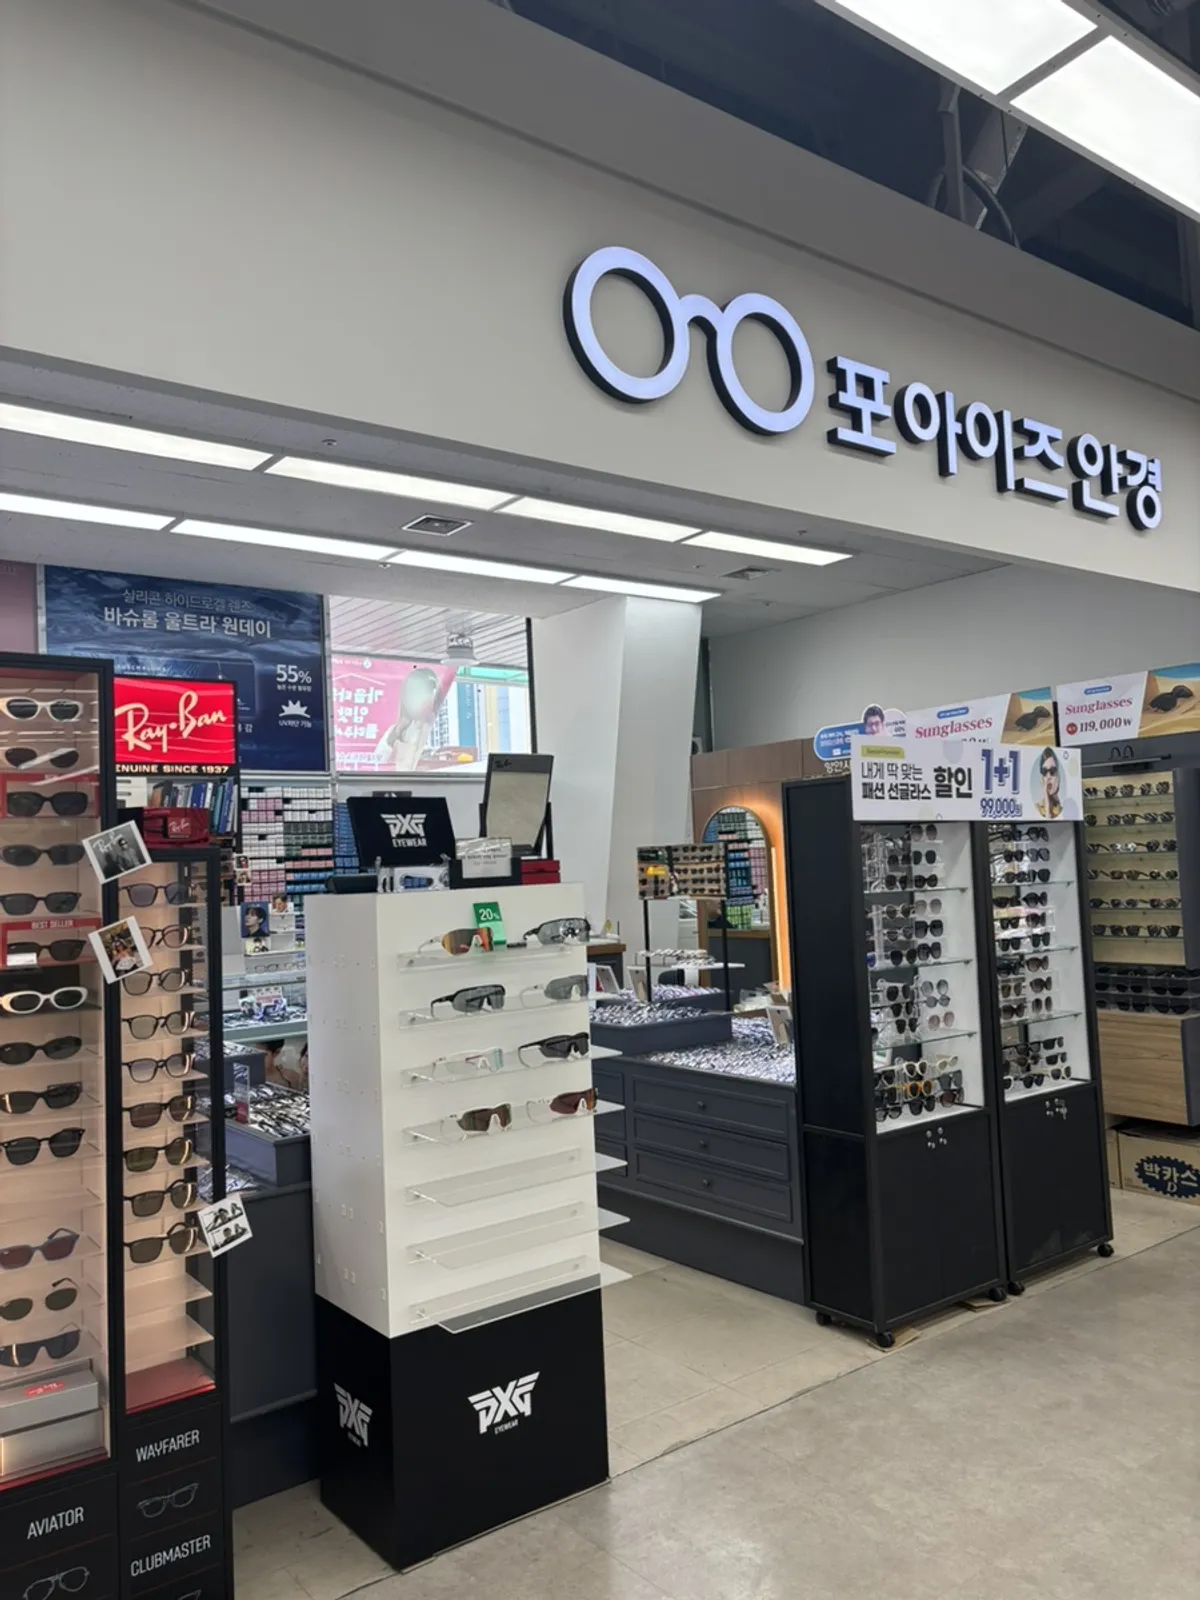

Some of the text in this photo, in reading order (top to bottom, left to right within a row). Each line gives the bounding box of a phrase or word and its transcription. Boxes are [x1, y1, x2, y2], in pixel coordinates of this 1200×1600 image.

[122, 588, 161, 606] 실리콘
[104, 607, 271, 638] 바슈롬 울트라 원데이
[276, 664, 312, 683] 55%
[1065, 697, 1133, 716] Sunglasses
[915, 717, 992, 739] Sunglasses
[163, 765, 198, 774] SINCE
[202, 765, 229, 774] 1937
[861, 761, 923, 781] 내게 딱 맞는
[981, 748, 1021, 795] 1+1
[861, 782, 932, 801] 패션 선글라스
[933, 765, 973, 799] 할인
[392, 838, 427, 848] EYEWEAR
[479, 908, 500, 921] 20%
[32, 919, 73, 930] BEST SELLER
[1143, 1161, 1198, 1187] 박카스
[1166, 1181, 1177, 1192] D
[136, 1429, 200, 1462] WAYFARER
[27, 1506, 84, 1540] AVIATOR
[130, 1534, 212, 1577] CLUBMASTER
